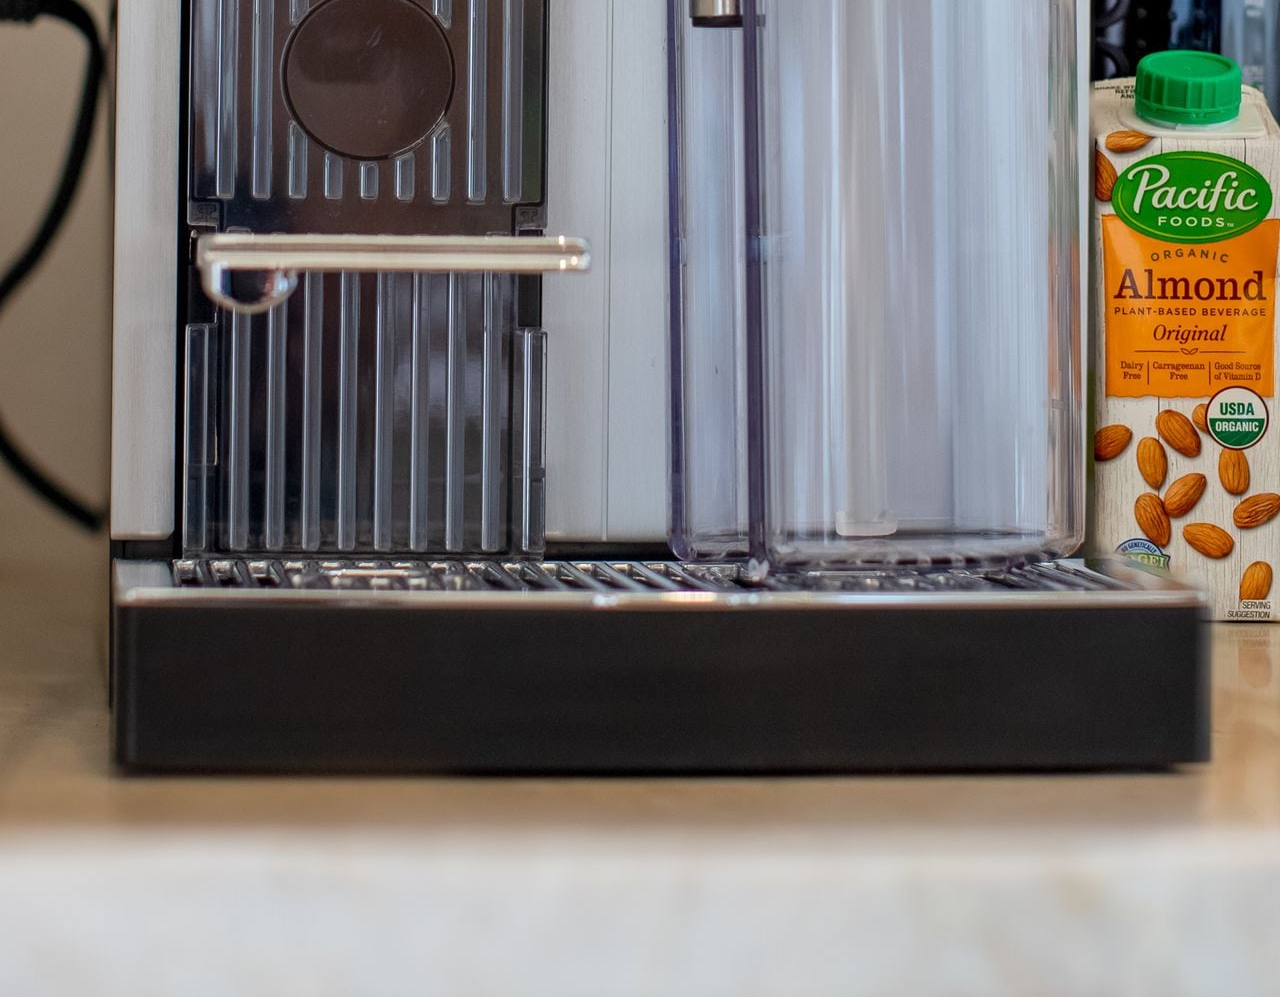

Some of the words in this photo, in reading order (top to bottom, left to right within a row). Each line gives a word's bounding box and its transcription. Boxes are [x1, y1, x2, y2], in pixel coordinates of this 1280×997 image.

[1127, 164, 1258, 213] Pacific
[1158, 217, 1225, 227] FOODS
[1151, 248, 1229, 263] ORGANIC
[1113, 269, 1266, 301] Almond
[1114, 307, 1197, 316] PLANT-BASED
[1201, 307, 1266, 317] BEVERAGE
[1153, 324, 1226, 345] Original
[1120, 361, 1143, 371] Dairy
[1152, 362, 1205, 371] Carrageenan
[1214, 362, 1233, 370] Good
[1235, 362, 1261, 370] Source
[1123, 372, 1141, 380] Free
[1170, 372, 1188, 380] Free
[1214, 372, 1222, 380] of
[1224, 372, 1253, 380] Vitamin
[1255, 372, 1261, 380] D
[1220, 402, 1254, 416] USDA
[1215, 421, 1259, 432] ORGANIC
[1242, 601, 1271, 609] SERVING
[1227, 610, 1270, 619] SUGGESTION
